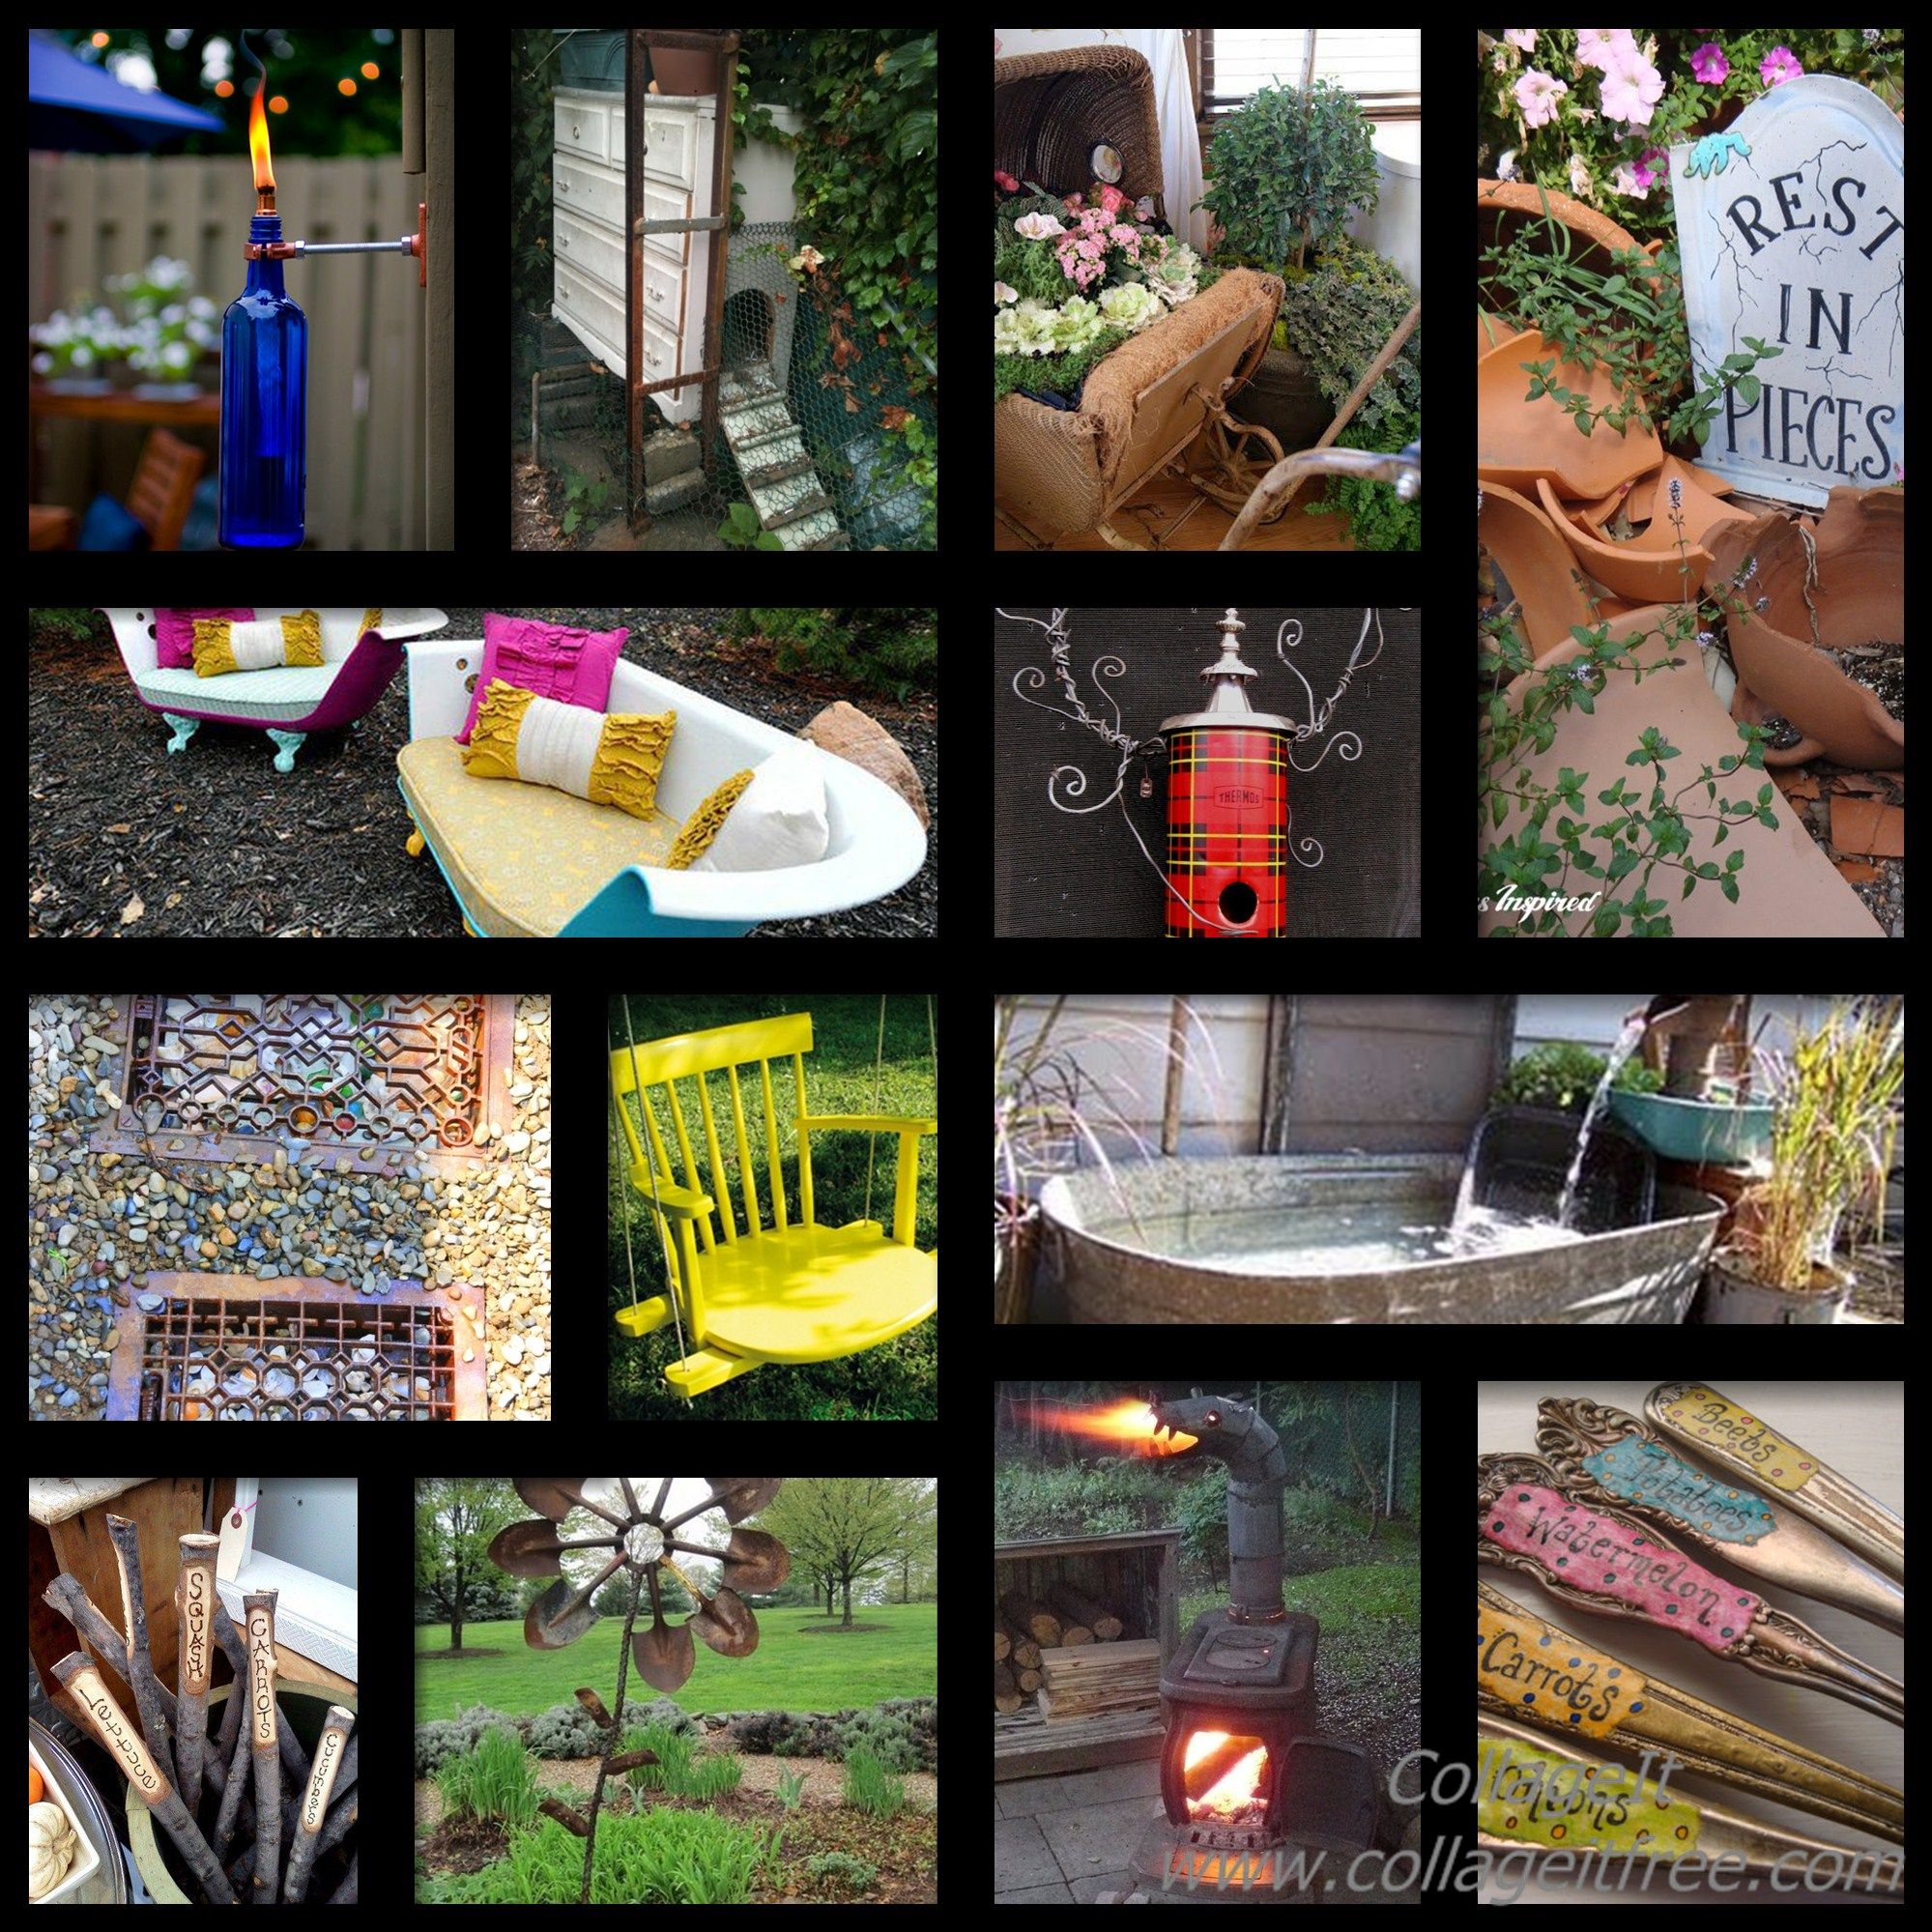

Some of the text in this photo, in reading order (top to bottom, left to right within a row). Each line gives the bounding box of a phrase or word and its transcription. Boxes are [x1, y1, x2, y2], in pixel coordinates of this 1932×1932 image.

[1726, 171, 1904, 261] REST
[1777, 284, 1854, 355] IN
[1725, 384, 1896, 480] PIECES
[1219, 790, 1259, 804] THERMOS
[1692, 1402, 1777, 1463] Beets
[1526, 1505, 1721, 1628] Watermelon
[187, 1572, 204, 1679] SQUASH
[250, 1618, 271, 1739] CARROTS
[1481, 1630, 1620, 1721] Carrots
[76, 1687, 157, 1790] Lettuce
